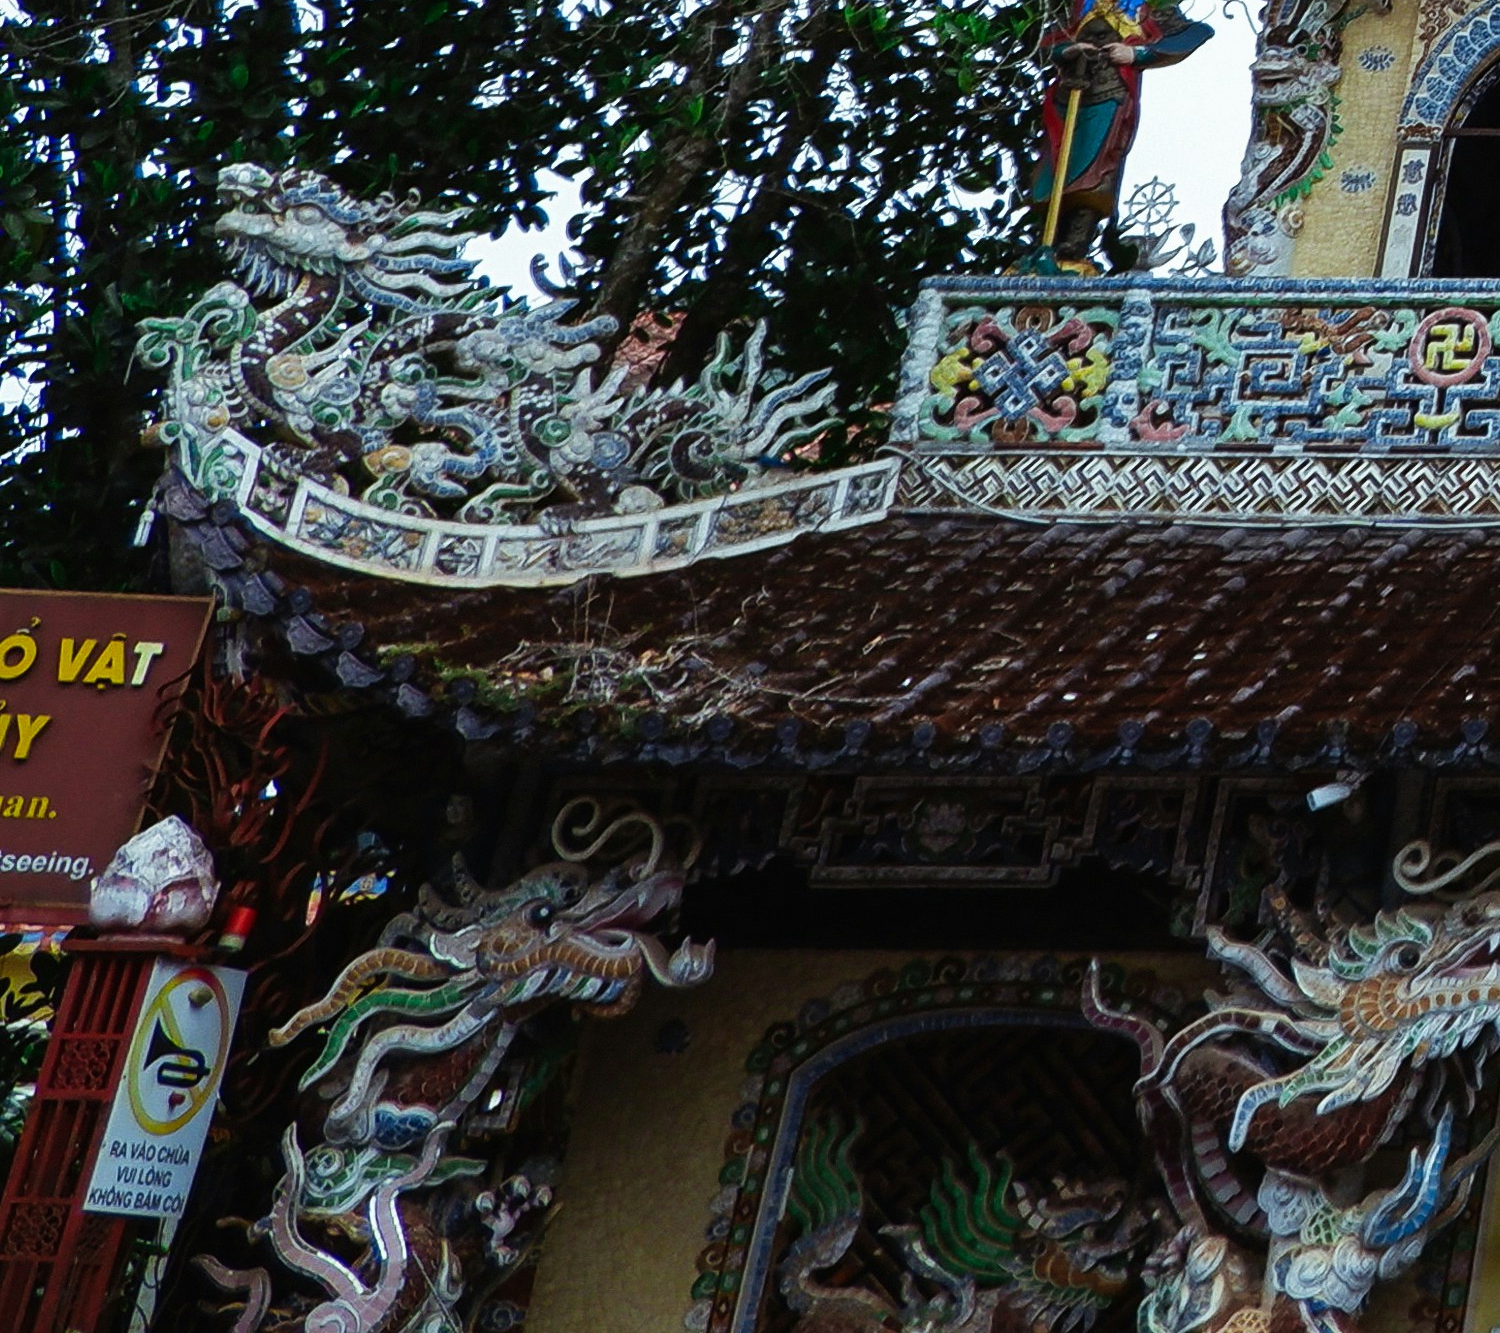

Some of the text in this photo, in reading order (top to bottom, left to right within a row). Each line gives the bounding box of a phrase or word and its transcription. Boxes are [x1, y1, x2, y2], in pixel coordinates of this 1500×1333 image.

[58, 632, 164, 690] VẬT
[0, 795, 57, 819] an.
[0, 850, 94, 880] seeing.
[117, 1166, 137, 1185] VUI
